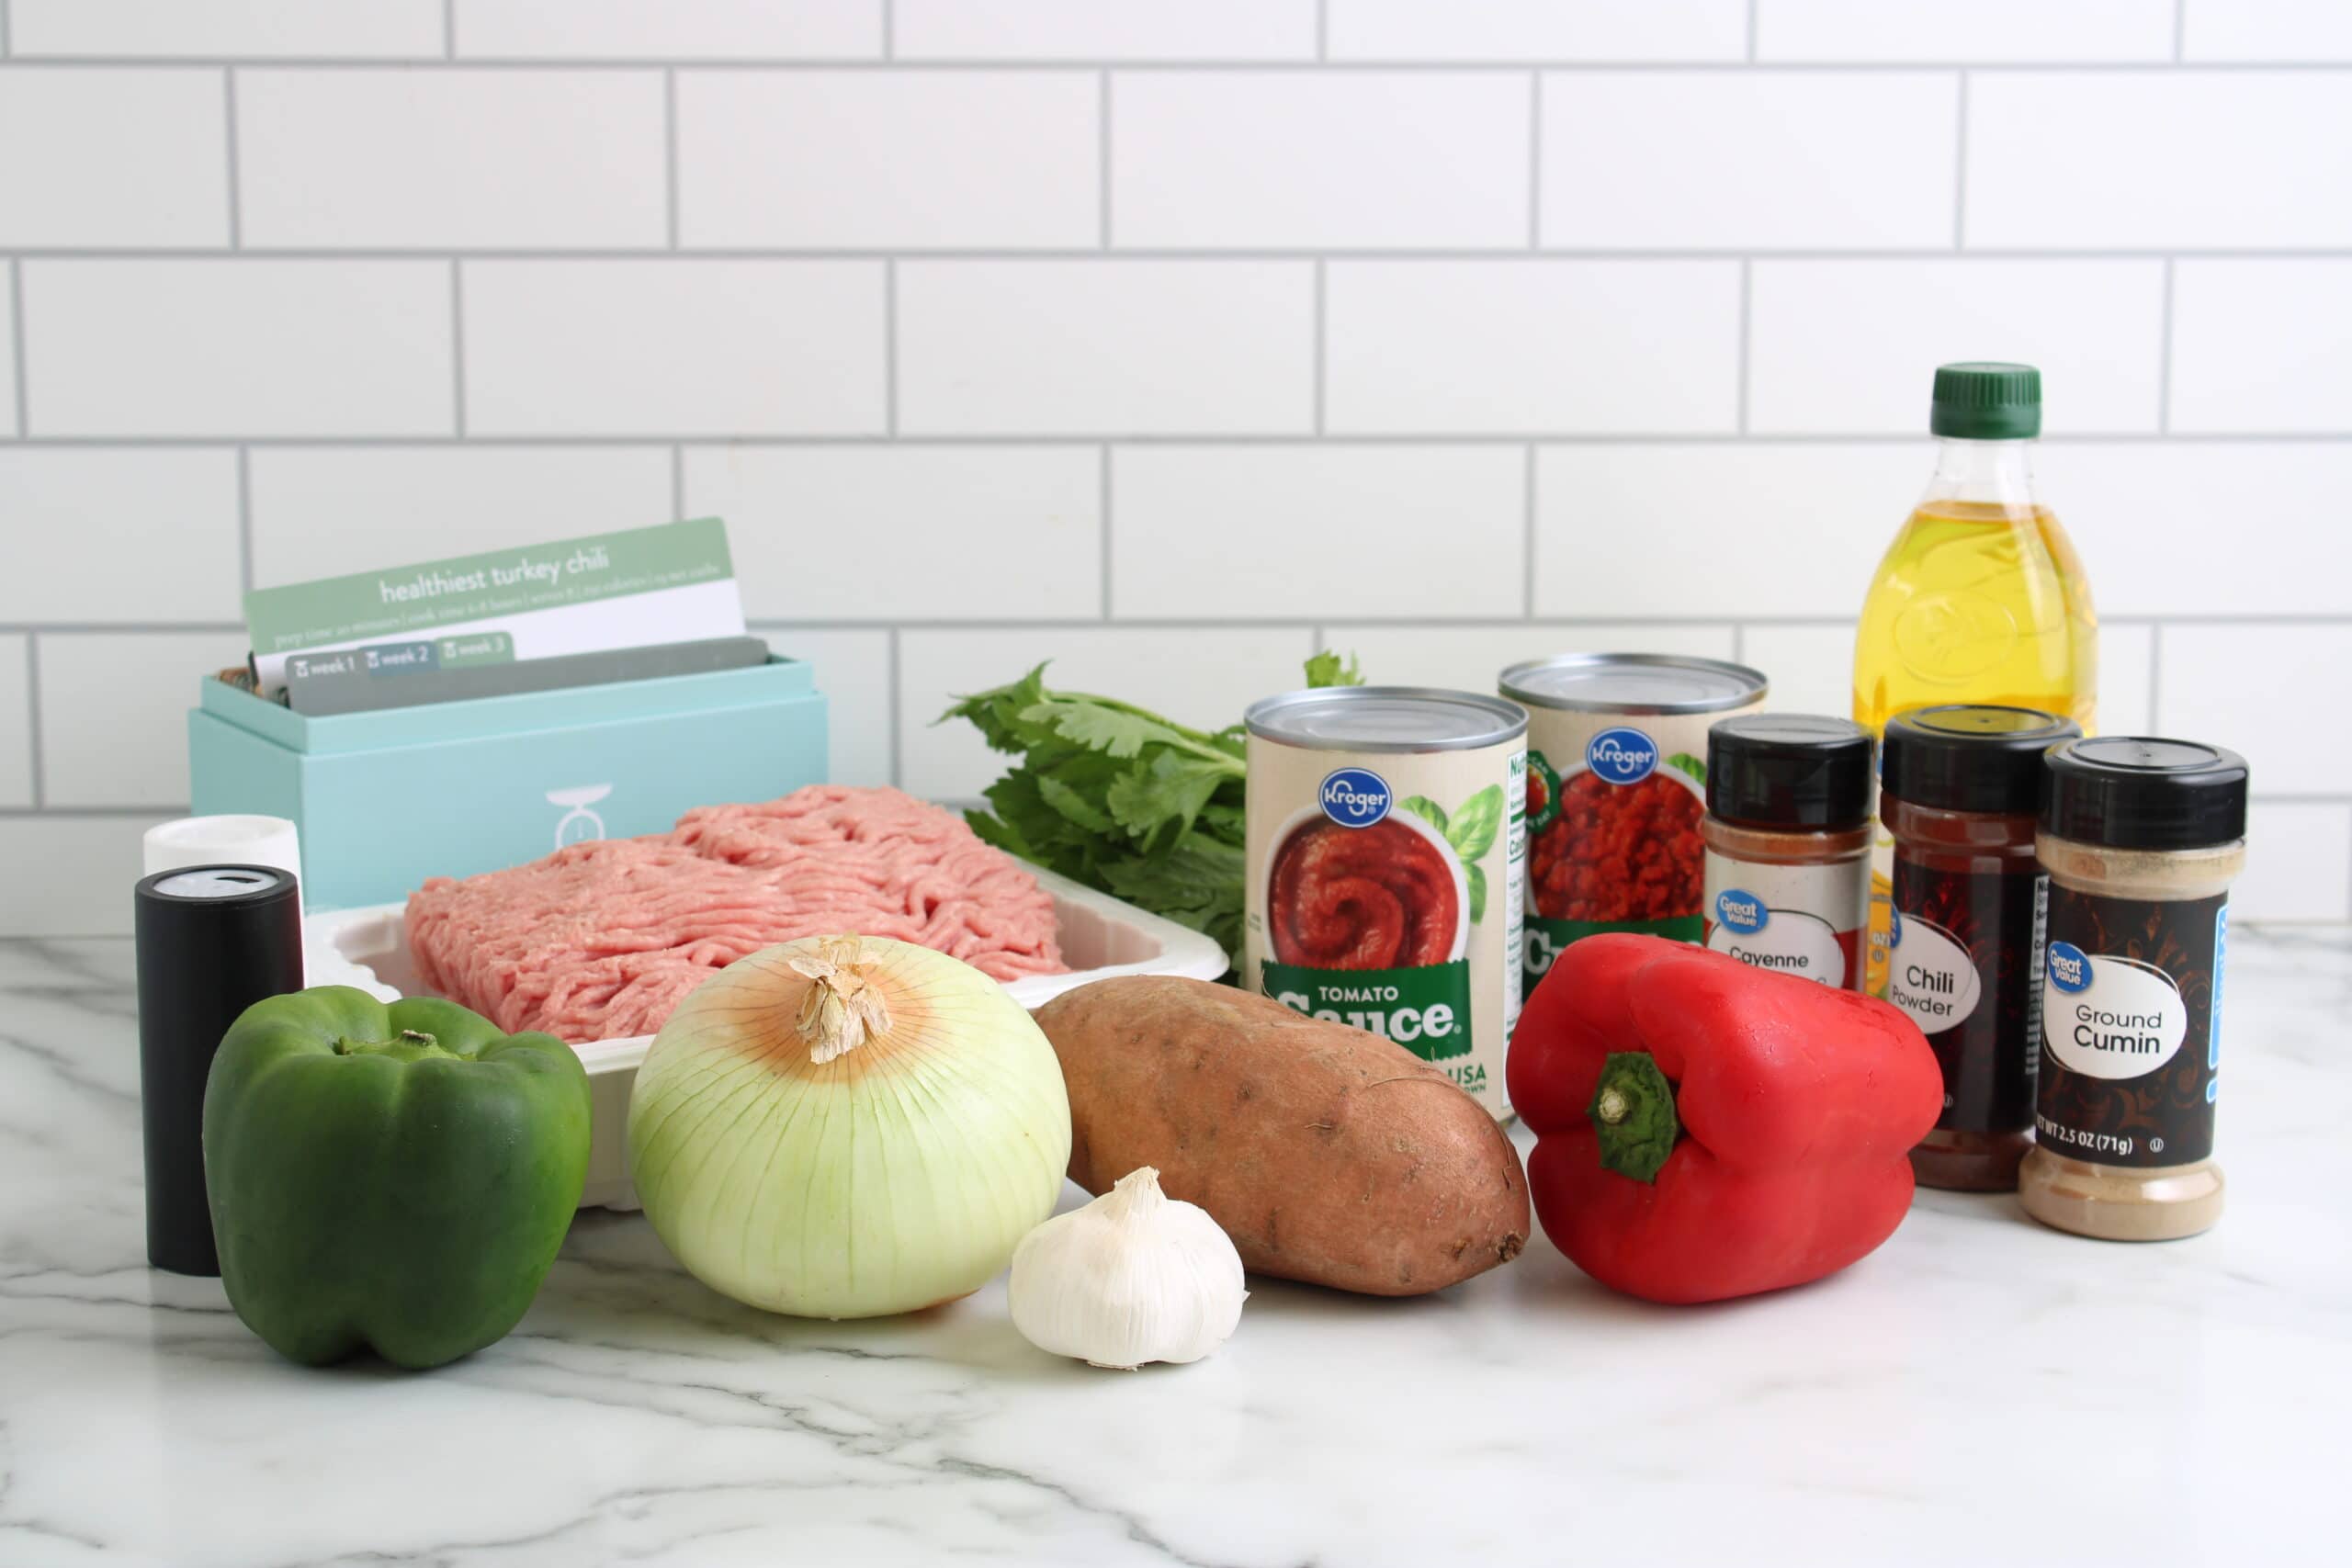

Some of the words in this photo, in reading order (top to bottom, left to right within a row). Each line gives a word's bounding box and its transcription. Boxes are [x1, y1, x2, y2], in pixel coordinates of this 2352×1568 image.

[379, 570, 487, 603] healthiest
[491, 558, 561, 587] turkey
[566, 546, 610, 574] chili
[381, 649, 415, 666] week
[418, 647, 429, 662] 2
[459, 639, 492, 656] week
[494, 636, 506, 651] 3
[311, 655, 345, 675] week
[347, 656, 356, 671] 1
[1592, 739, 1653, 773] Kroger
[1324, 780, 1386, 817] Kroger
[1720, 897, 1757, 917] Great
[1727, 911, 1757, 926] Value
[1730, 946, 1809, 967] Cayenne
[2050, 950, 2082, 975] Great
[1906, 965, 1954, 994] Chili
[2054, 966, 2082, 986] Value
[1318, 986, 1399, 1002] TOMATO
[1893, 985, 1954, 1016] Powder
[2075, 1004, 2162, 1029] Ground
[2074, 1024, 2160, 1053] Cumin
[1447, 1063, 1487, 1085] USA
[2045, 1121, 2058, 1138] WT
[2059, 1126, 2075, 1144] 2.5
[2078, 1131, 2095, 1147] OZ
[2097, 1134, 2133, 1156] (71g)
